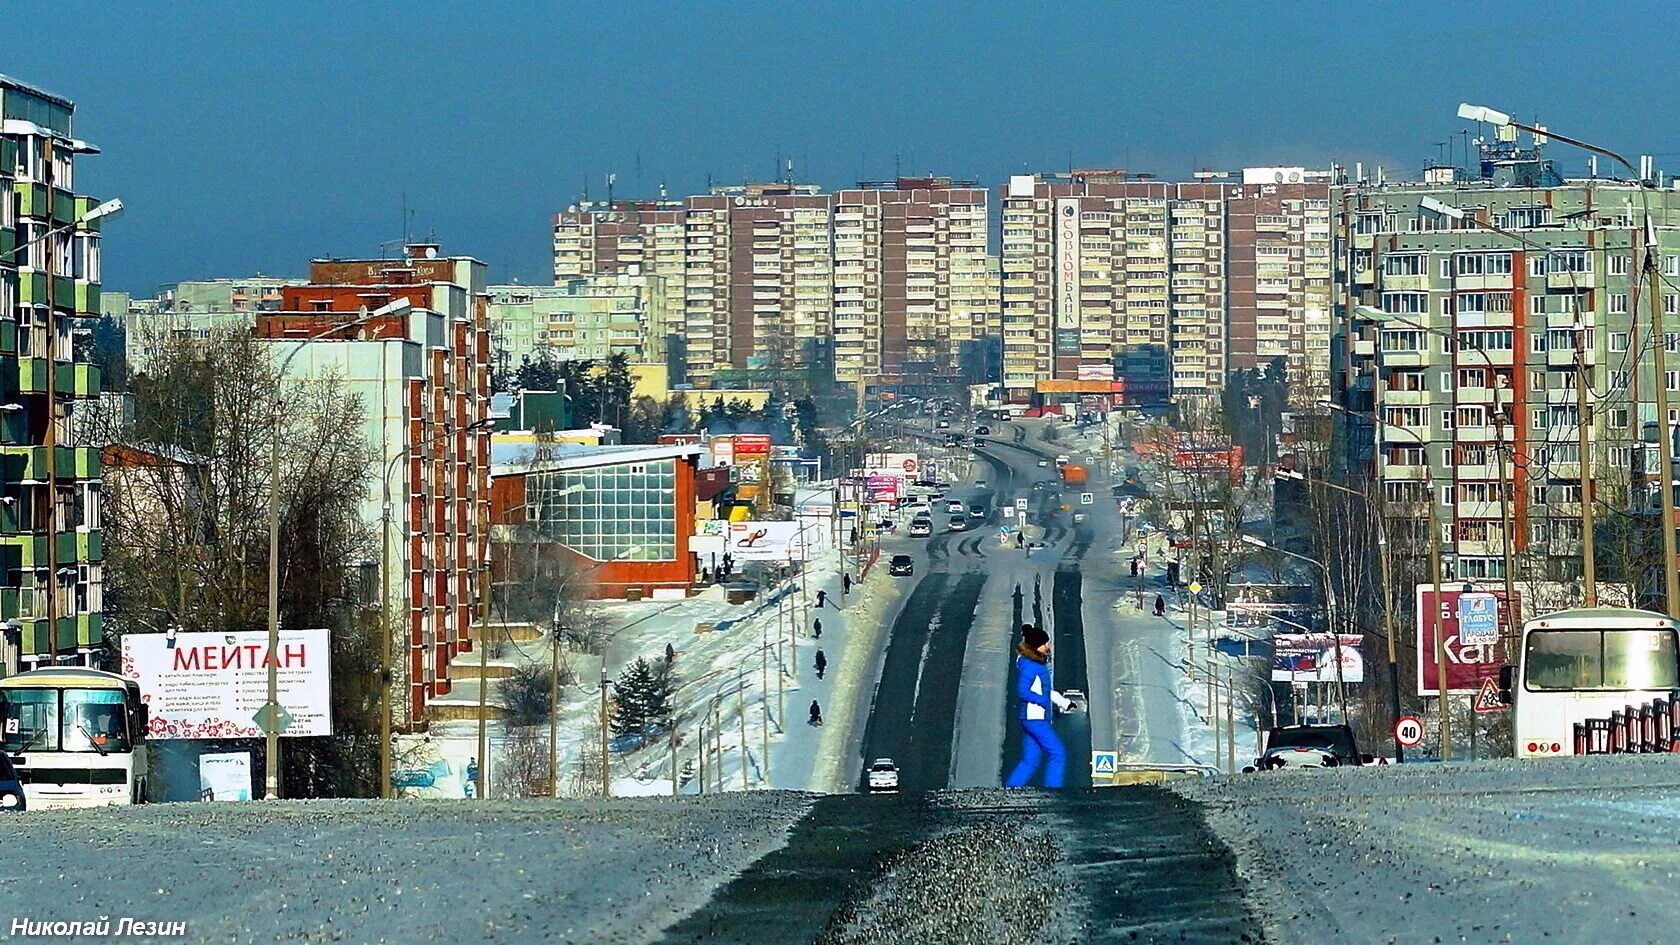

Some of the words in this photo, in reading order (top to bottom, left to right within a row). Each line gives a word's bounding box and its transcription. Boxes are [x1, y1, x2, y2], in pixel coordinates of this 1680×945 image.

[1063, 219, 1074, 323] СОВКОМБАНК
[9, 722, 15, 731] 2
[1402, 727, 1416, 738] 40
